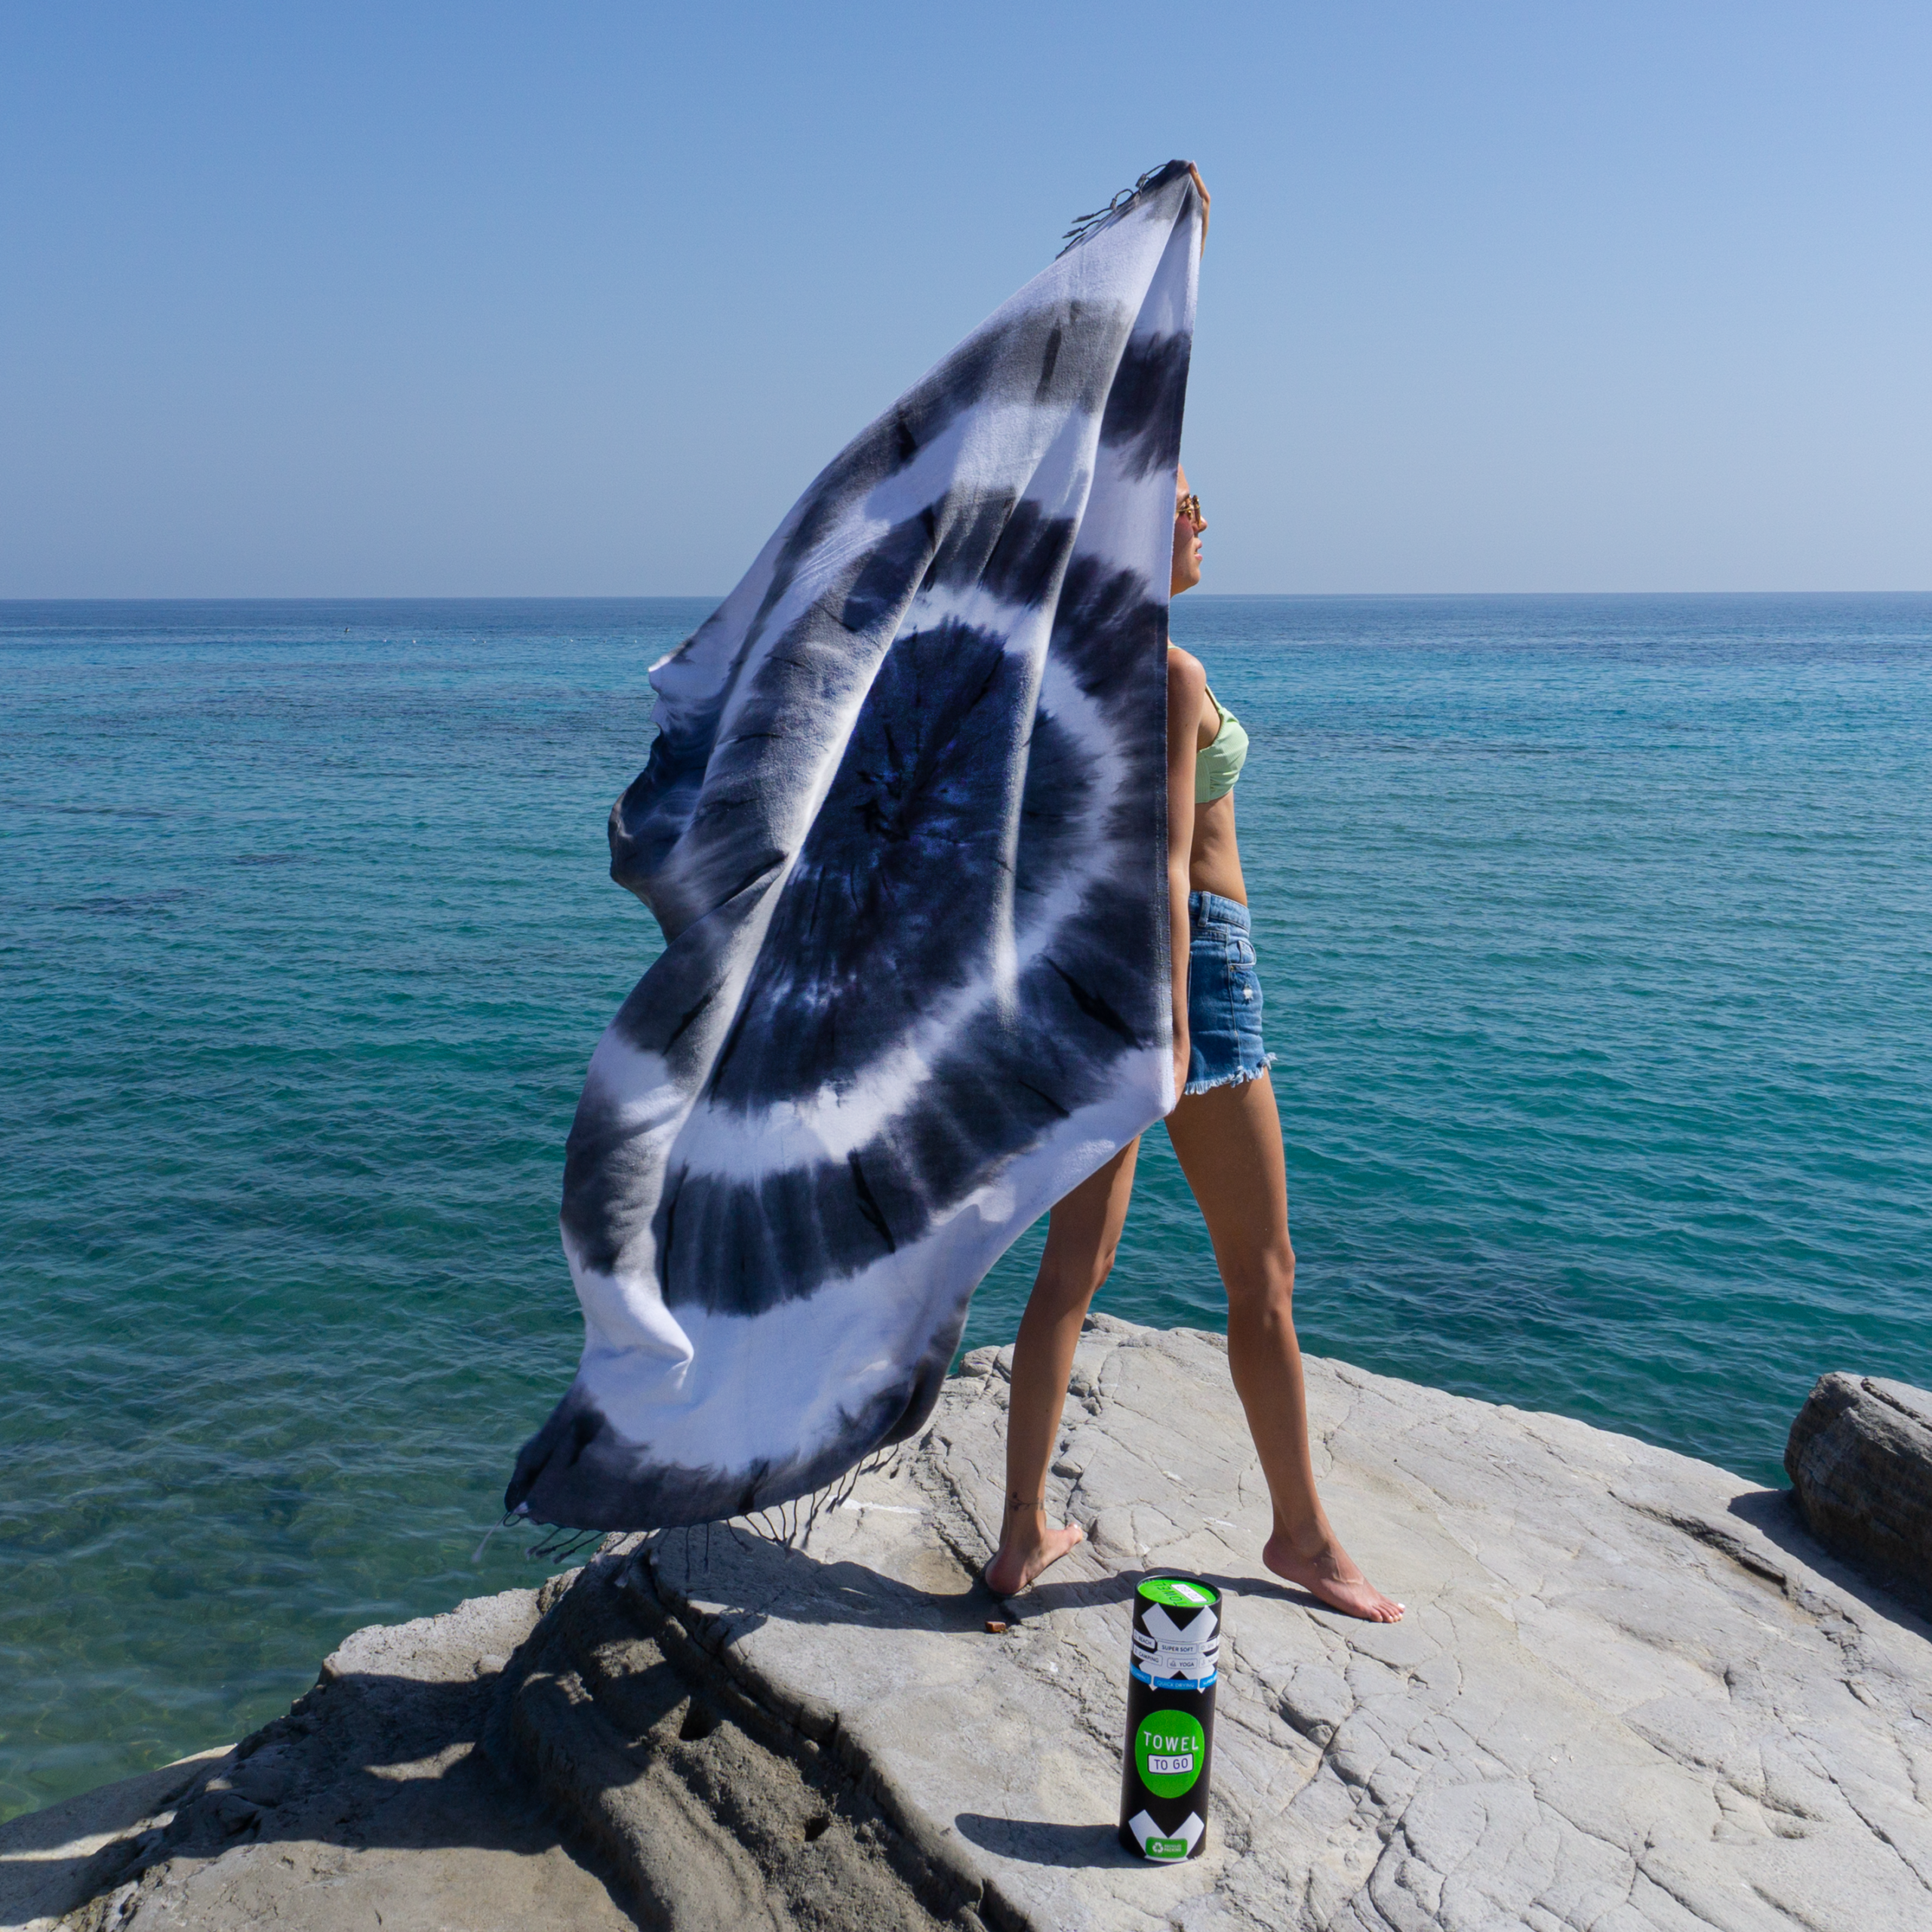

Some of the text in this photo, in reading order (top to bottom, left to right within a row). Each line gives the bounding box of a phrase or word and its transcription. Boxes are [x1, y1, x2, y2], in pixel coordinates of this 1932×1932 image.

[1139, 1636, 1152, 1645] BEACH
[1139, 1652, 1159, 1663] CAMPING
[1143, 1730, 1198, 1752] TOWEL
[1154, 1758, 1189, 1770] TO GO
